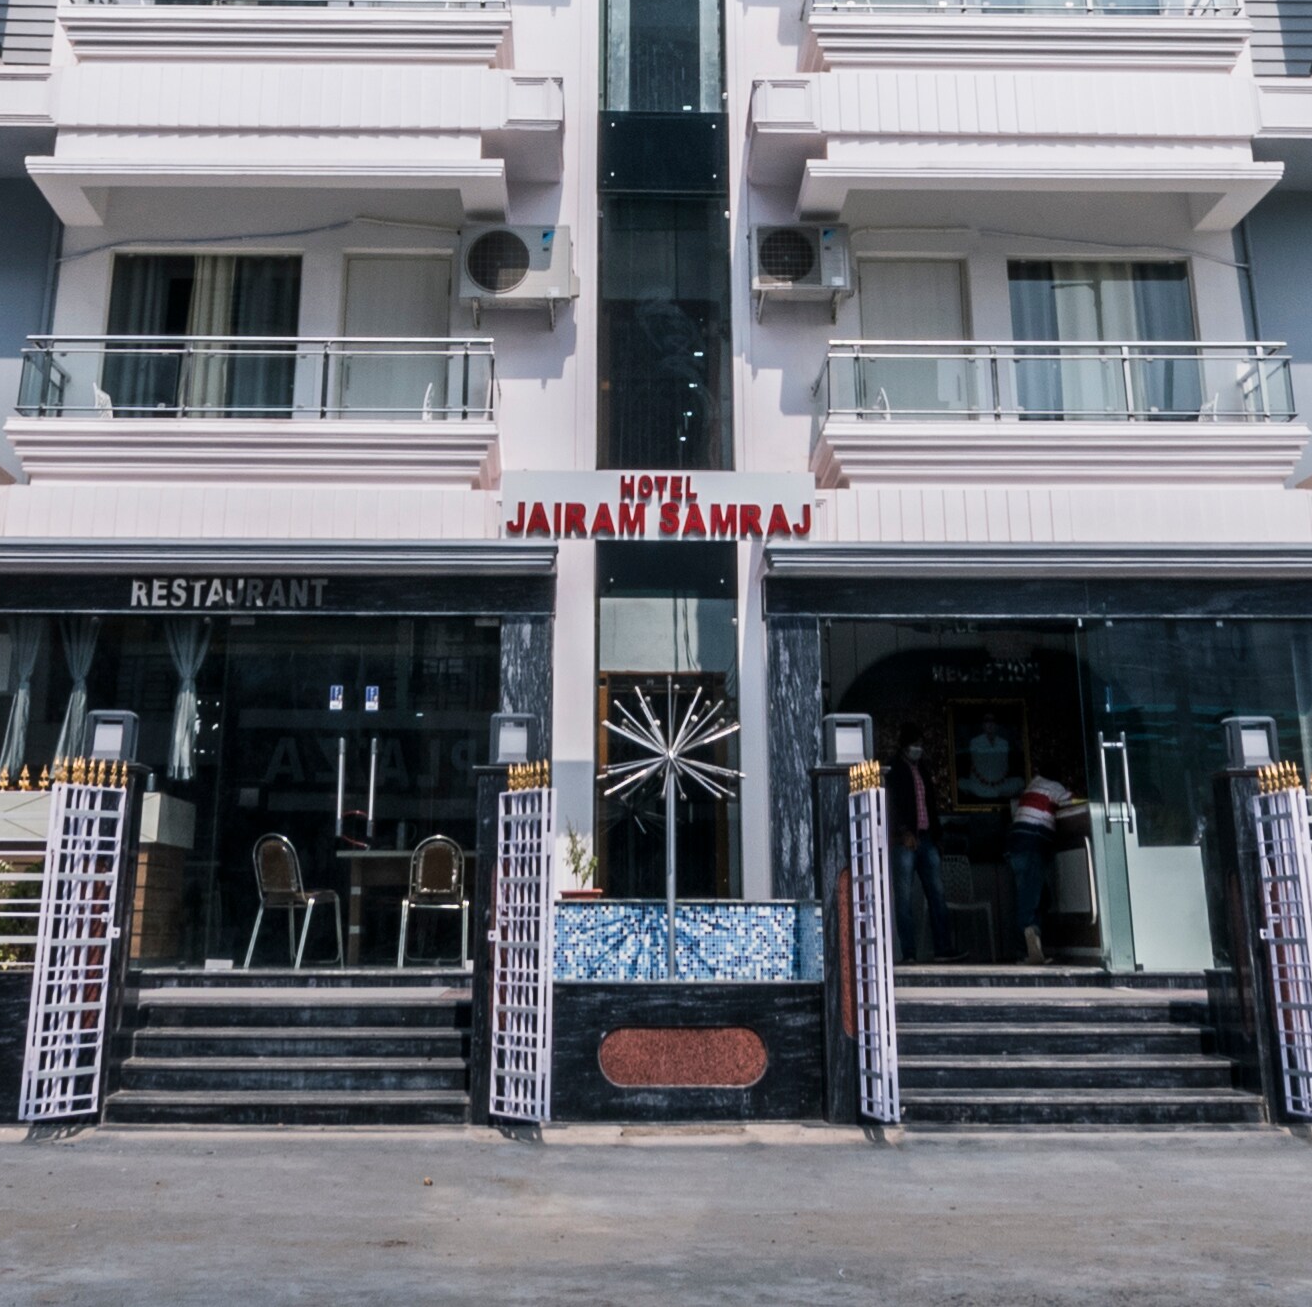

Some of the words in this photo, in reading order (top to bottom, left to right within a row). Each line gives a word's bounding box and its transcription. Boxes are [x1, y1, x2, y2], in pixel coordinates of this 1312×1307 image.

[620, 475, 698, 501] HOTEL
[506, 501, 646, 534] JAIRAM
[659, 502, 812, 536] SAMRAJ
[130, 578, 329, 608] RESTAURANT
